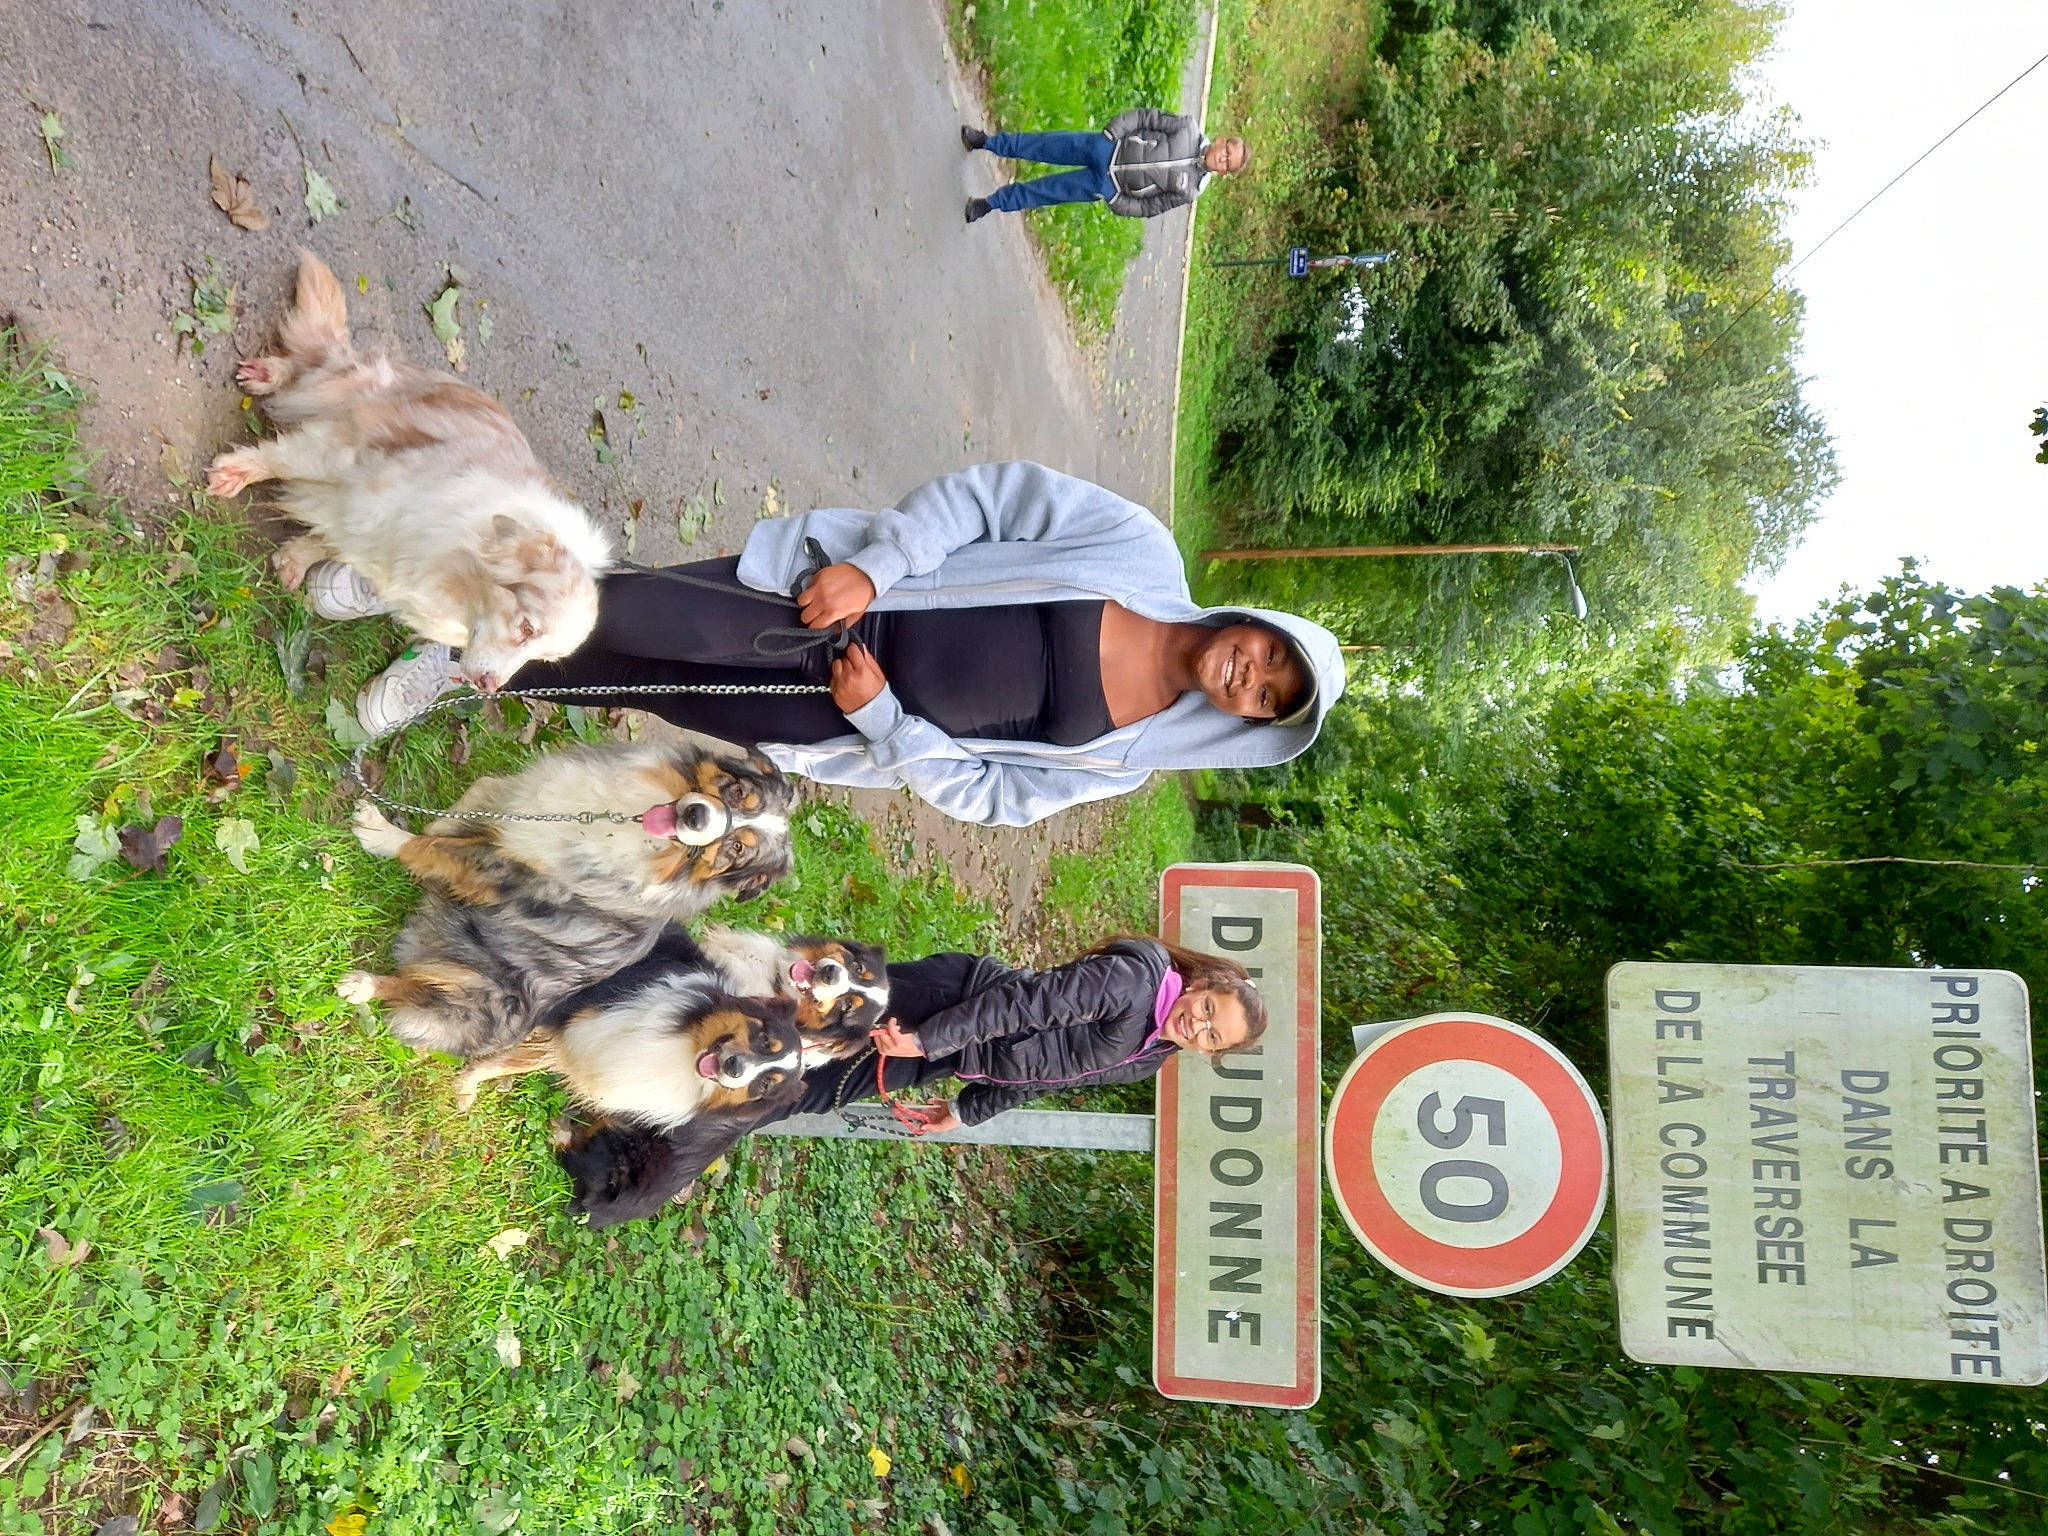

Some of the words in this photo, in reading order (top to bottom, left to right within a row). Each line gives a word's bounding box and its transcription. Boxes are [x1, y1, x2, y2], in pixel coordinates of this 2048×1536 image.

[1654, 989, 1703, 1041] DE
[1656, 1055, 1705, 1105] LA
[1930, 975, 1989, 1166] PRIORITE
[1207, 916, 1264, 1347] DUDONNE
[1417, 1090, 1510, 1223] 50
[1747, 1050, 1807, 1287] TRAVERSEE
[1840, 1069, 1895, 1180] DANS
[1940, 1177, 1991, 1204] A
[1658, 1122, 1715, 1341] COMMUNE
[1848, 1217, 1899, 1269] LA
[1943, 1217, 2001, 1378] DROITE
